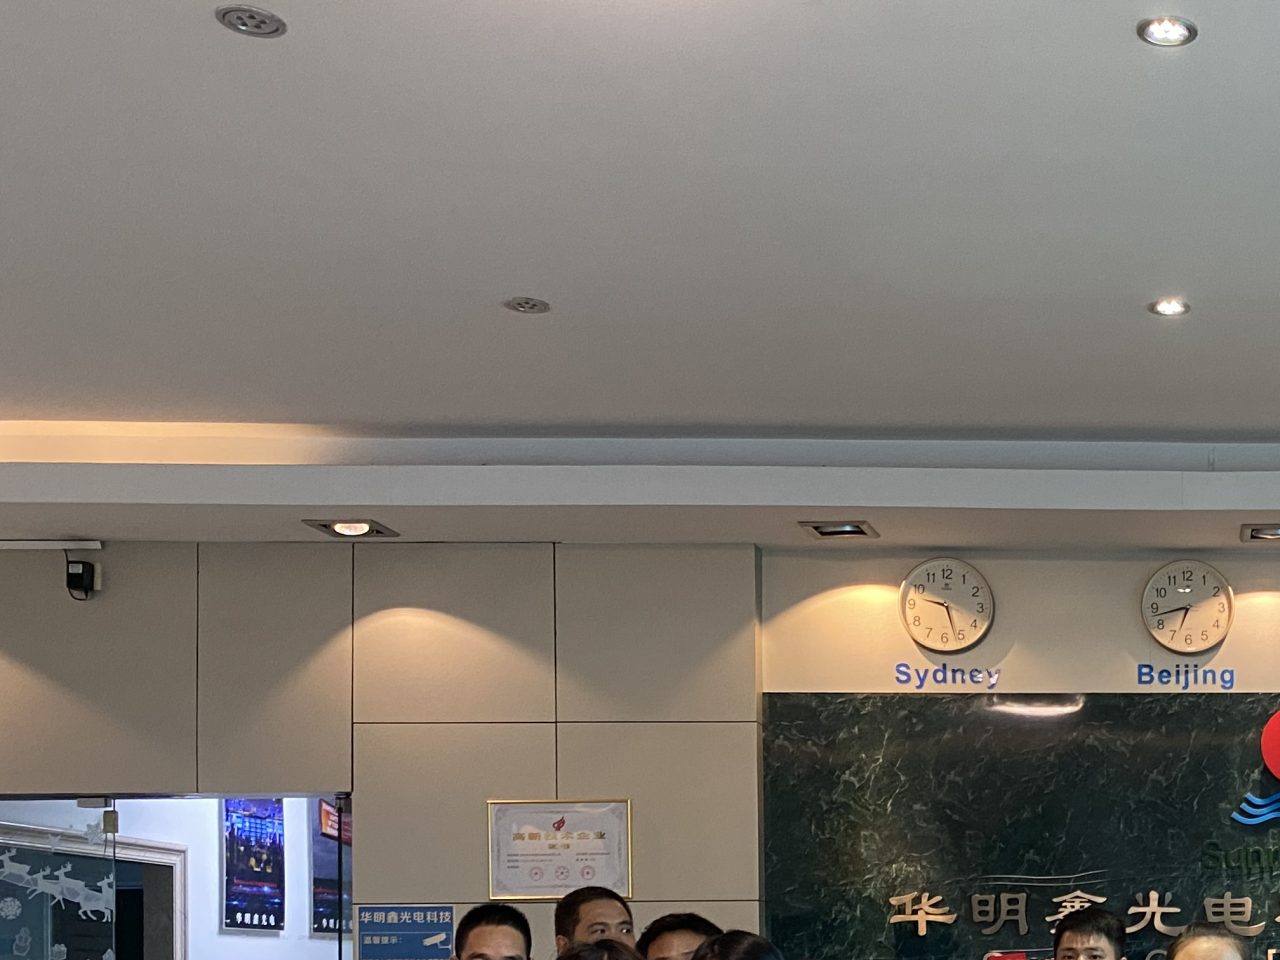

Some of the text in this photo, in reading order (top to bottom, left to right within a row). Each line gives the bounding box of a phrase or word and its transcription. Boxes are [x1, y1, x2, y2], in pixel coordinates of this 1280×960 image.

[926, 572, 936, 583] 11
[942, 568, 953, 580] 12
[961, 574, 966, 584] 1
[1182, 570, 1193, 581] 12
[1168, 575, 1176, 586] 11
[1202, 574, 1206, 586] 1
[913, 584, 925, 594] 10
[971, 586, 980, 597] 2
[1156, 587, 1167, 598] 10
[1212, 586, 1220, 597] 2
[908, 599, 915, 609] 9
[976, 603, 984, 614] 3
[1151, 602, 1159, 613] 9
[1218, 602, 1225, 613] 3
[913, 615, 920, 627] 8
[970, 619, 977, 630] 4
[1157, 619, 1165, 630] 8
[1212, 619, 1219, 630] 4
[925, 627, 933, 639] 7
[941, 632, 949, 644] 6
[957, 630, 965, 641] 5
[1169, 629, 1177, 641] 7
[1201, 630, 1208, 641] 5
[1184, 634, 1192, 645] 6
[895, 663, 1000, 689] Sydney
[1137, 663, 1235, 689] Beijing
[360, 911, 452, 924] 华明鑫光电科技
